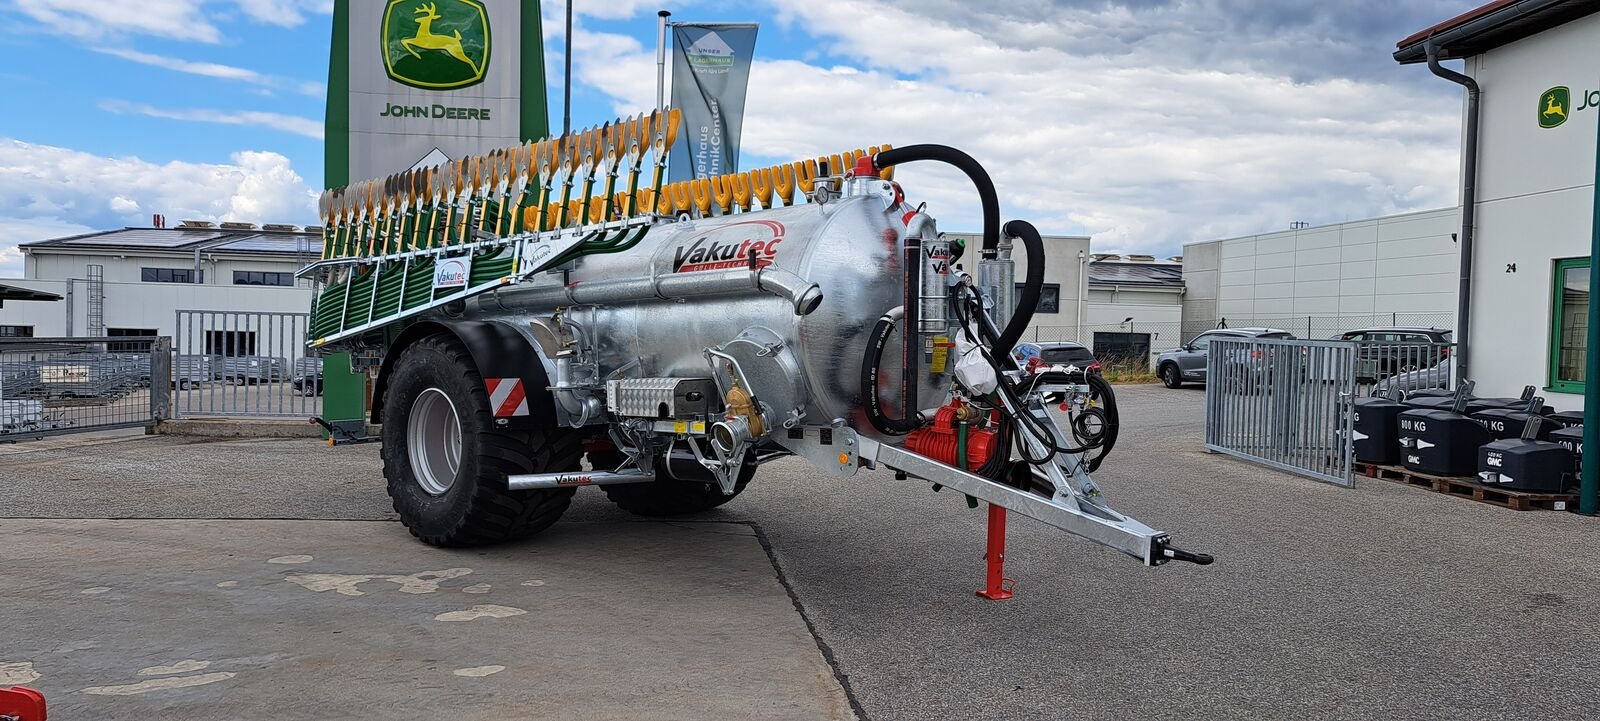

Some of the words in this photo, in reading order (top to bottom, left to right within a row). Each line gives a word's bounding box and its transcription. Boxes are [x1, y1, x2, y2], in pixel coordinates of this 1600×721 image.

[380, 102, 429, 118] JOHN
[431, 104, 491, 120] DEERE
[708, 100, 720, 177] hnikCenter
[696, 126, 708, 180] gerhaus
[672, 237, 783, 273] Vakutec
[1505, 263, 1517, 273] 24
[437, 268, 466, 286] Vakutec
[1154, 332, 1159, 341] 7
[1414, 421, 1427, 432] KG
[1491, 420, 1505, 432] KG
[1408, 455, 1420, 465] GMC
[1487, 457, 1503, 467] GMC
[554, 474, 592, 485] Vakutec
